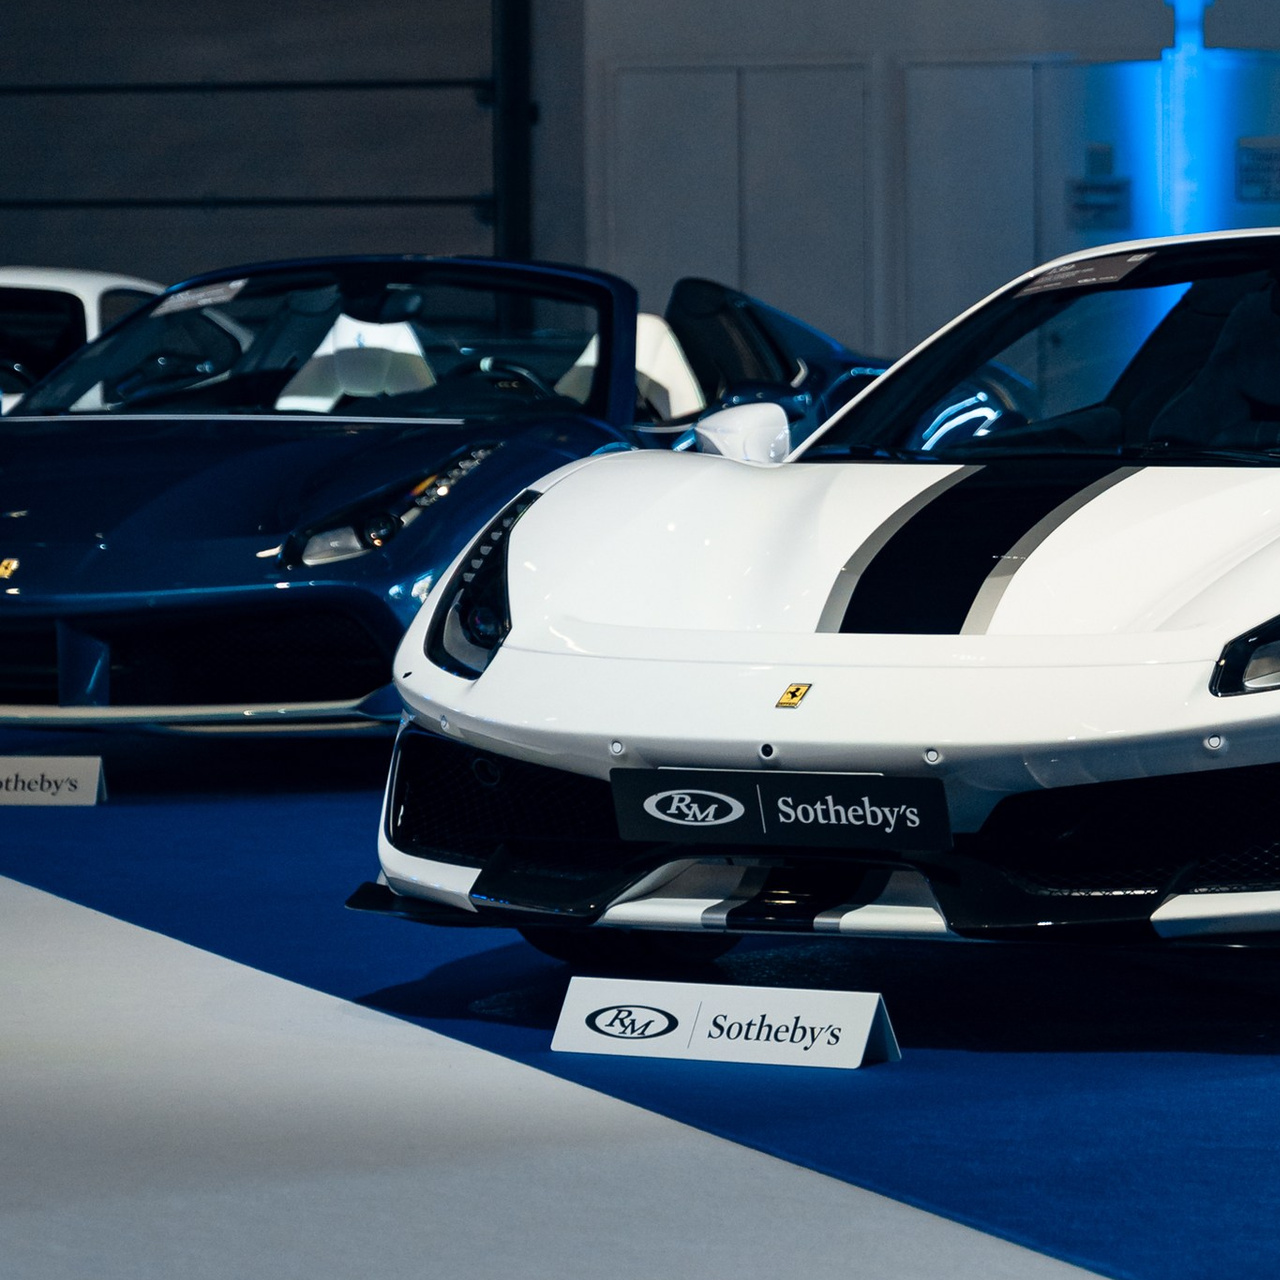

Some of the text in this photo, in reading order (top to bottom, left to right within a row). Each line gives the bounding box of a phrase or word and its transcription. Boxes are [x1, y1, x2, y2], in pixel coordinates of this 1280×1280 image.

[0, 773, 78, 796] theby's
[777, 795, 921, 833] Sotheby's
[707, 1013, 842, 1051] Sotheby's
